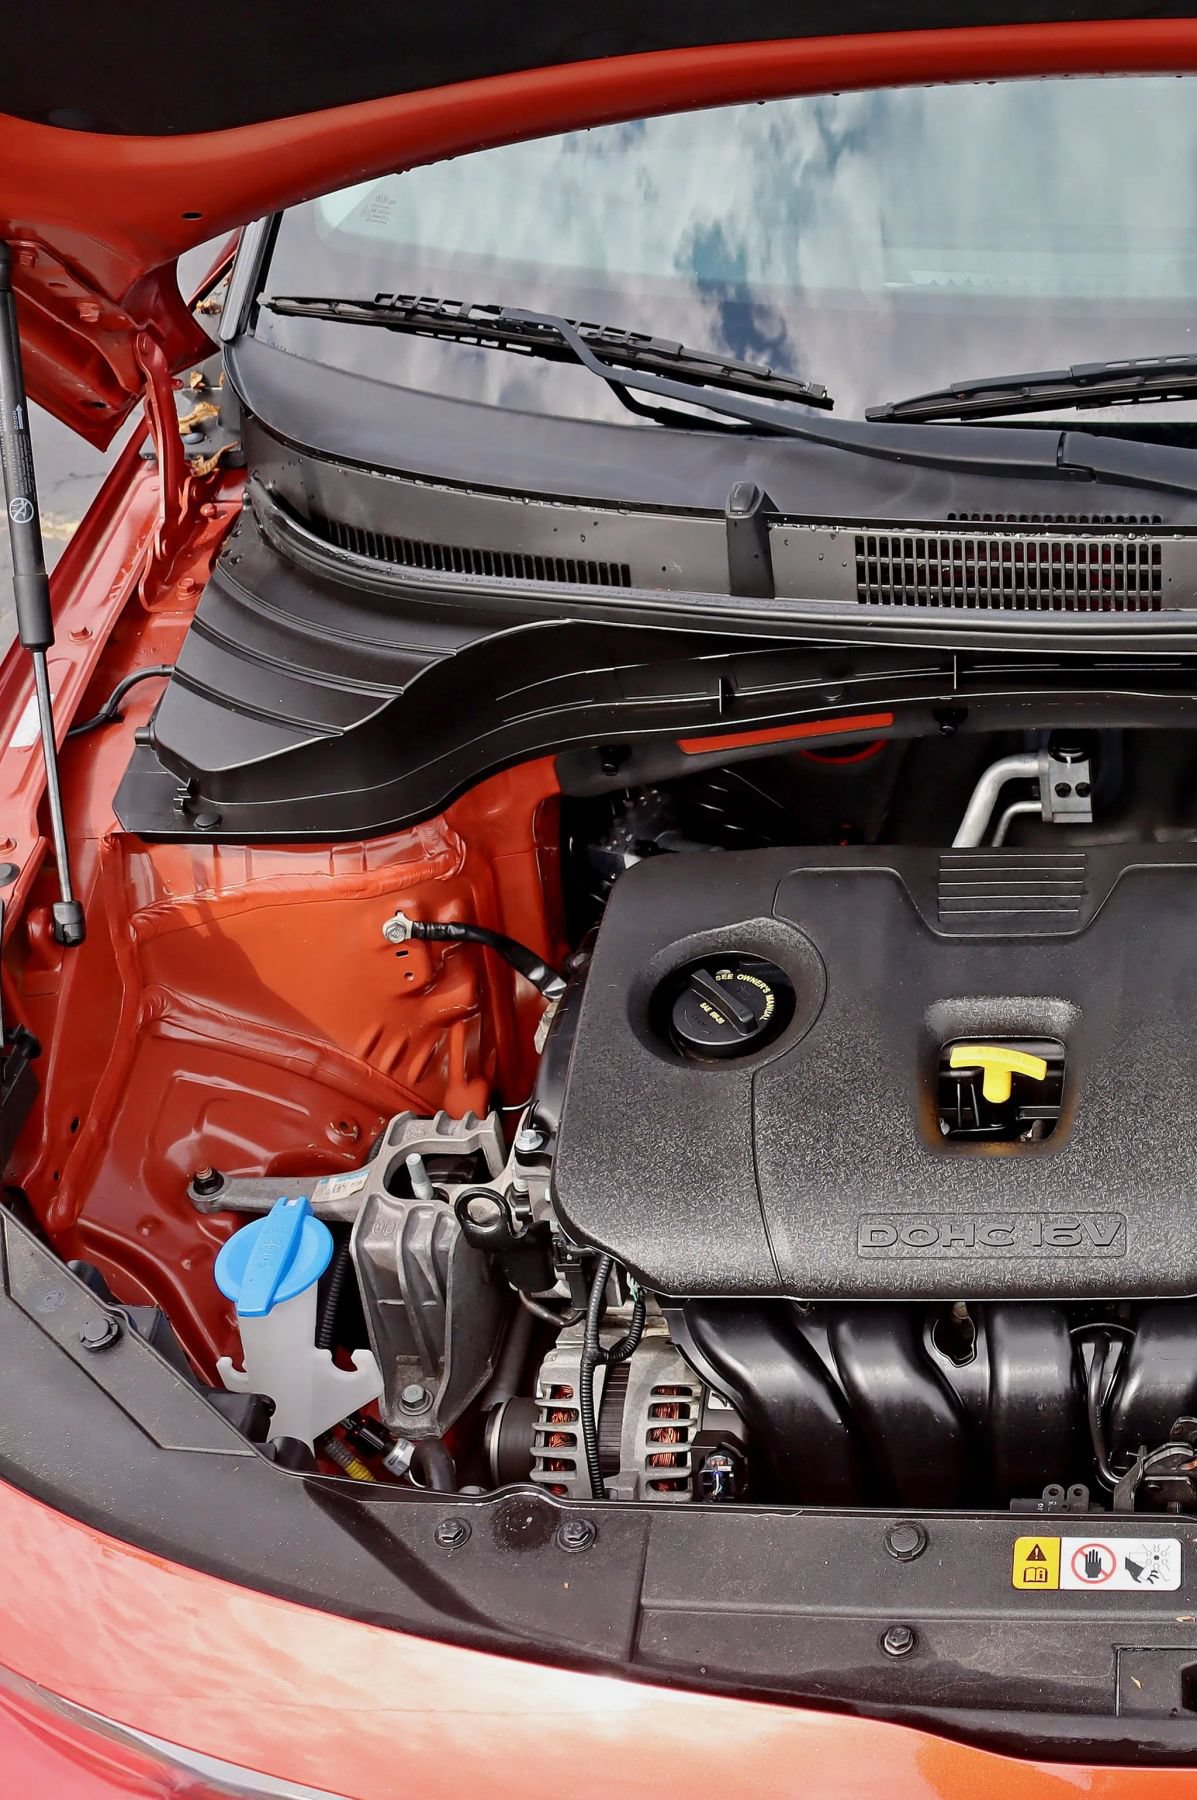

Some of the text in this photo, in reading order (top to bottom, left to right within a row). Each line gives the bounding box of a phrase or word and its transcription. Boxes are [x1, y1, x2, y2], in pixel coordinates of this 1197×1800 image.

[715, 973, 775, 1021] SEE OWNER'S MANUAL
[861, 1221, 1122, 1248] DOHC 16V
